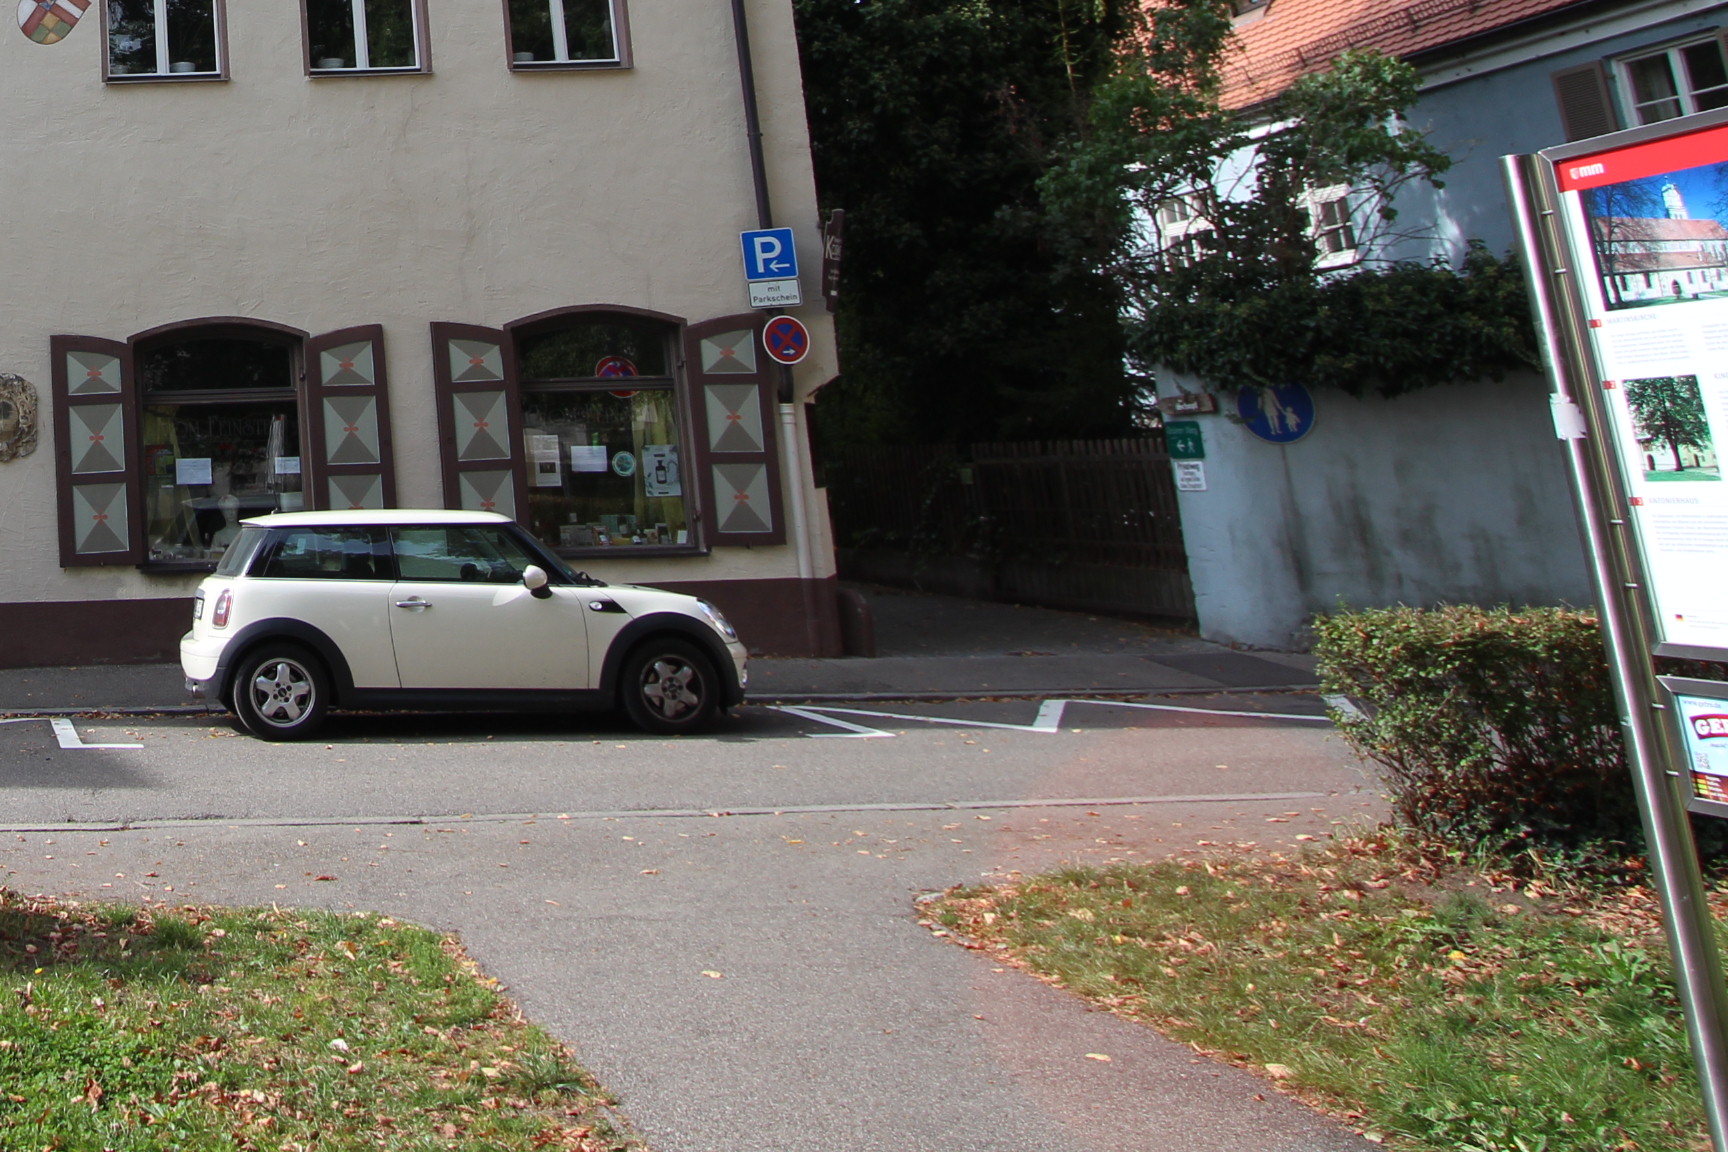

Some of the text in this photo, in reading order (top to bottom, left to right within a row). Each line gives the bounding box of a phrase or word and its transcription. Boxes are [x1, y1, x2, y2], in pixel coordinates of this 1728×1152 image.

[753, 236, 782, 273] P
[767, 285, 781, 293] mit
[753, 293, 798, 303] Parkschein
